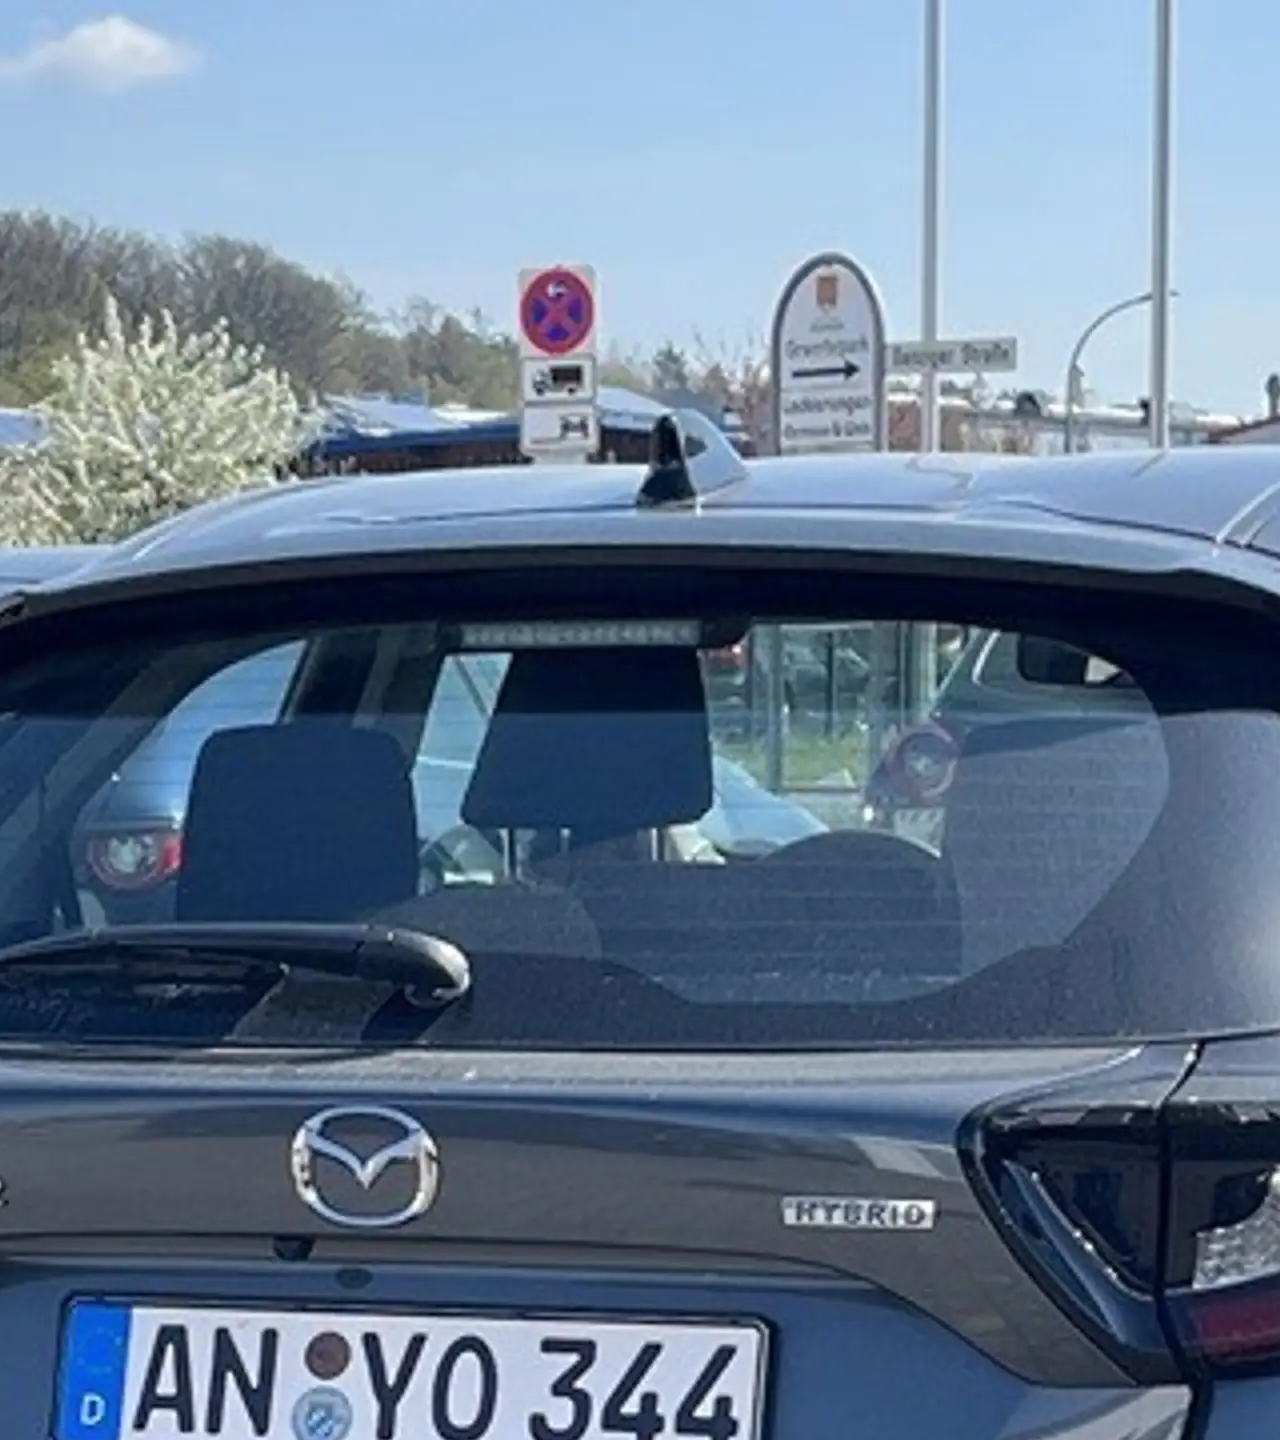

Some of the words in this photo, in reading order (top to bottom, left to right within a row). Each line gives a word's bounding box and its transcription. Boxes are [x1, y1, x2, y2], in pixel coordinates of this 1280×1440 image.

[793, 1199, 927, 1228] HYBRID
[131, 1323, 278, 1437] AN
[80, 1393, 106, 1426] D
